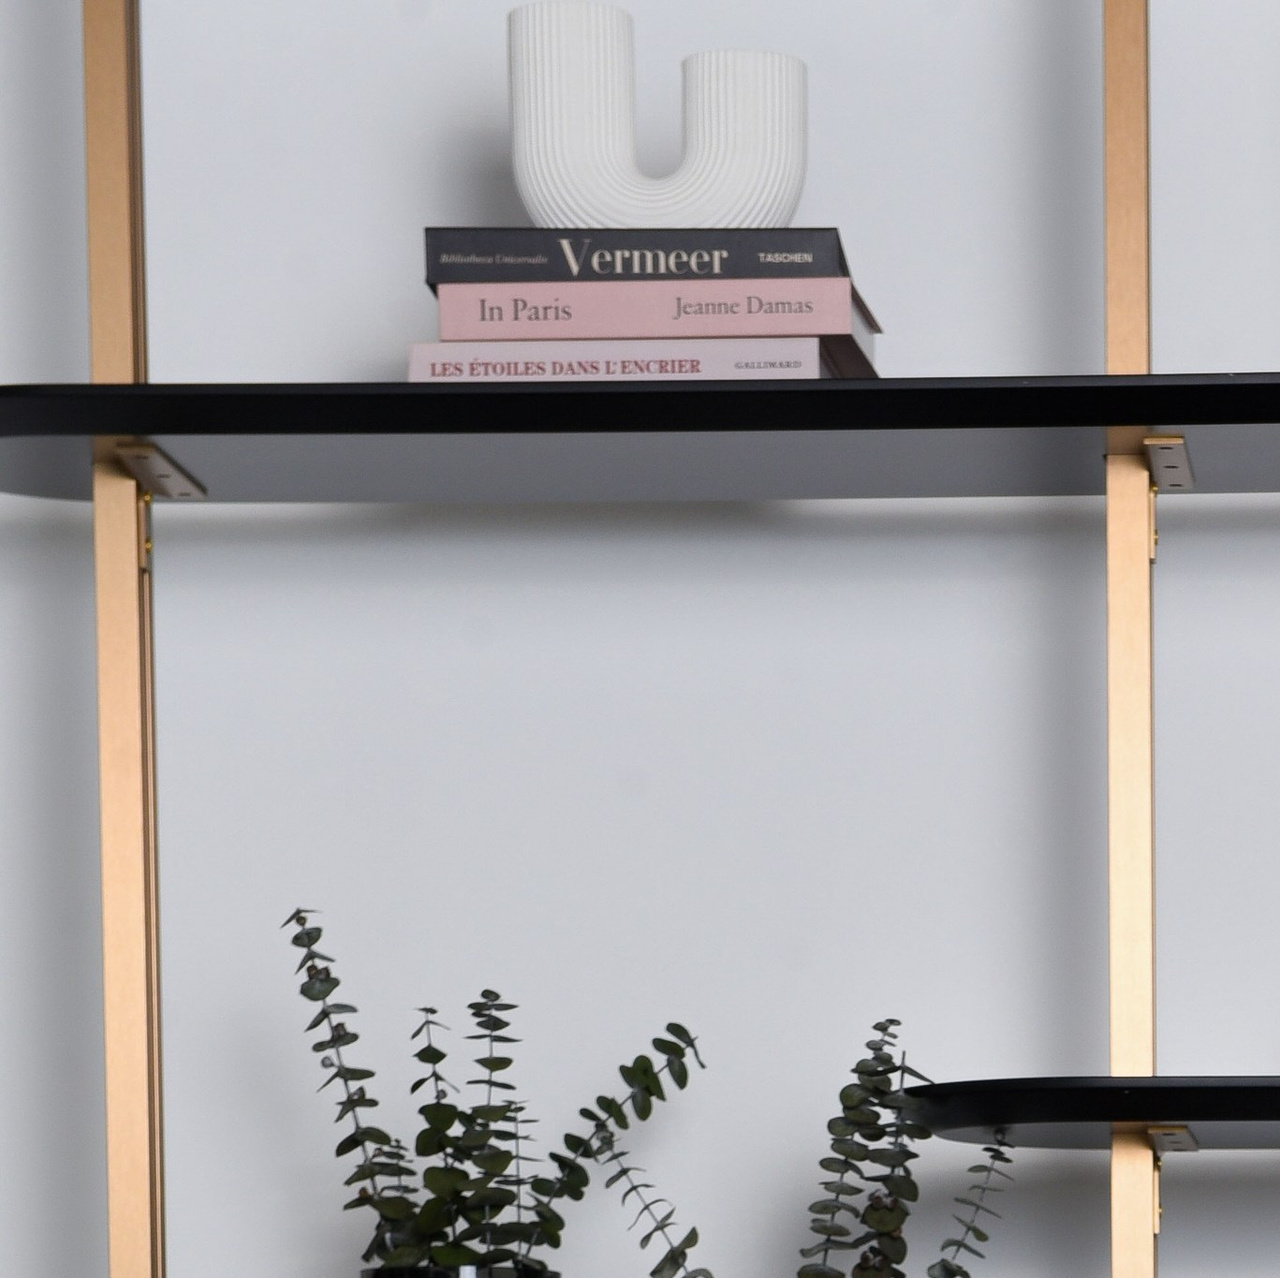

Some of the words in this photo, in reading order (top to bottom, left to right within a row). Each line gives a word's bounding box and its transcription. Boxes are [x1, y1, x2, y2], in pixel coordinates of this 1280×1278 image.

[558, 238, 729, 277] Vermeer
[758, 252, 814, 263] TASCHEN
[479, 298, 504, 322] In
[512, 297, 573, 322] Paris
[672, 296, 741, 321] Jeanne
[746, 295, 814, 315] Damas
[430, 361, 464, 377] LES
[468, 358, 547, 377] ÉTOILES
[551, 360, 601, 376] DANS
